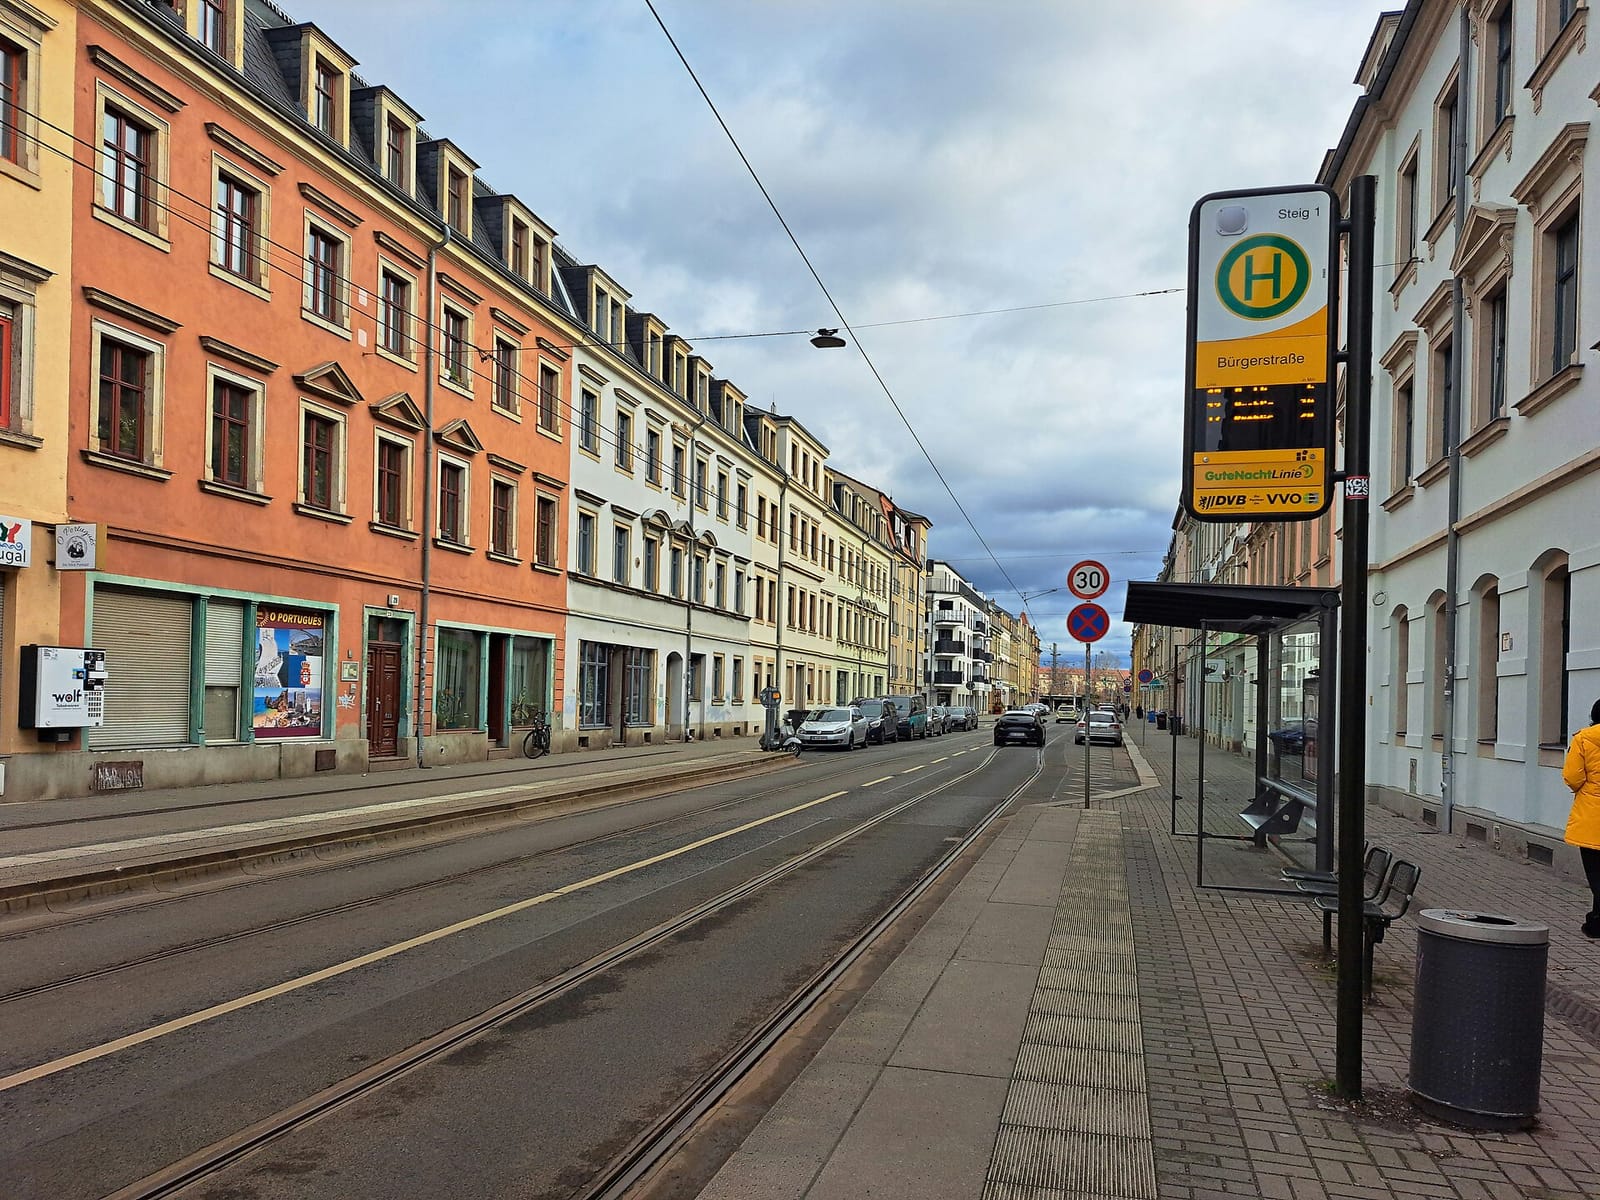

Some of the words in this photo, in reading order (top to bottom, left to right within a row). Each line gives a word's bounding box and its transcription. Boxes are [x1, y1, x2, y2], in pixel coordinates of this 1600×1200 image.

[1278, 208, 1310, 220] Steig
[1314, 207, 1321, 217] 1
[1244, 253, 1281, 301] H
[1217, 353, 1305, 369] Bürgerstraße
[1205, 469, 1302, 481] GuteNachtLinie
[1346, 478, 1368, 487] KCK
[1346, 487, 1368, 496] NZS
[1267, 493, 1302, 505] VVO
[1076, 571, 1101, 589] 30
[269, 612, 276, 622] O
[52, 689, 82, 703] wolf
